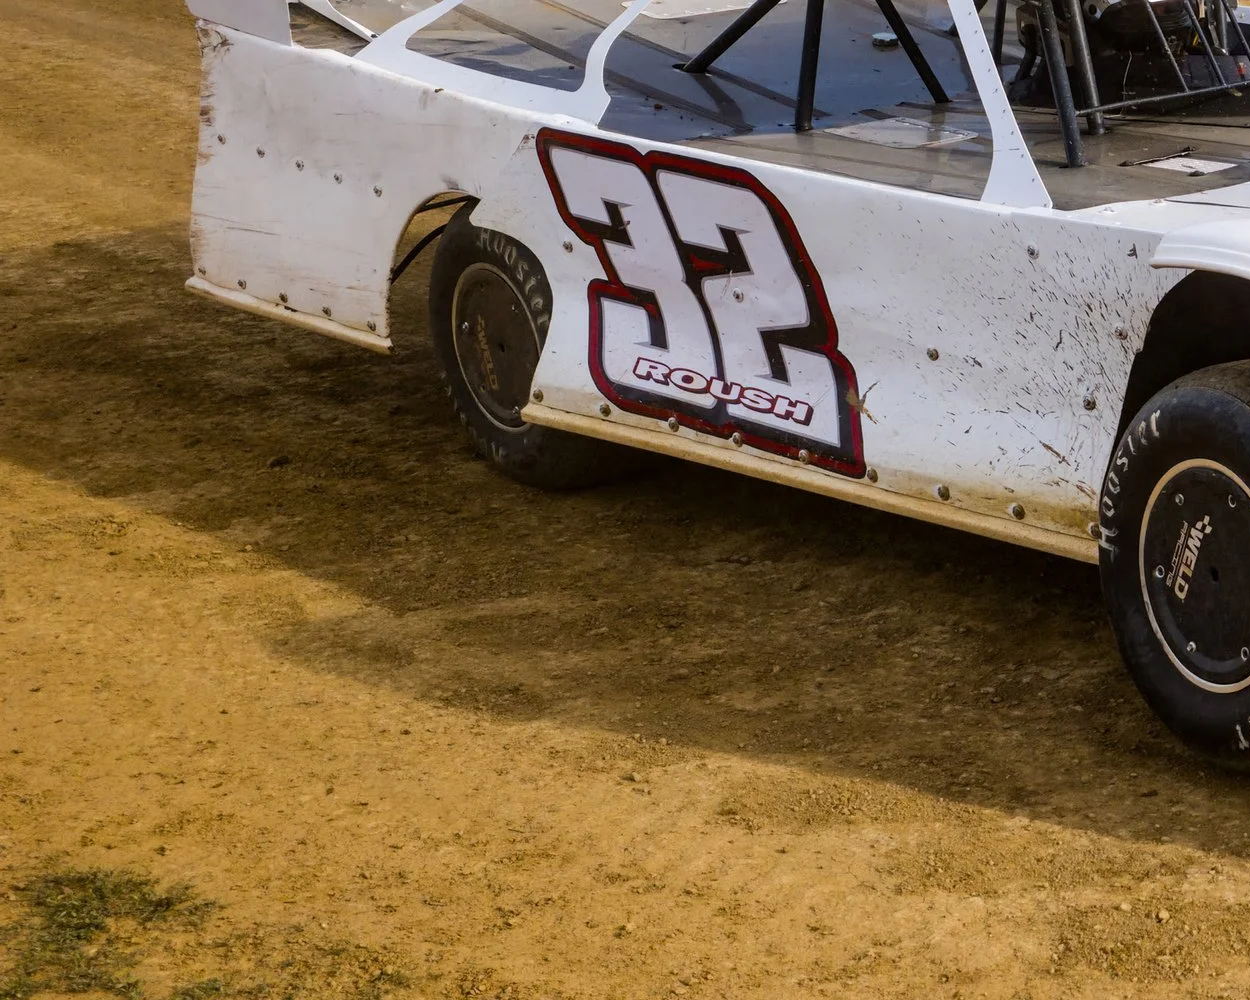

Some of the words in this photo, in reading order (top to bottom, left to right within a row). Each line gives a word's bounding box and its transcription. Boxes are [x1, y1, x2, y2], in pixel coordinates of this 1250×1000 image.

[540, 131, 862, 472] 32
[476, 329, 498, 391] WELD
[633, 357, 813, 426] ROUSH
[1174, 525, 1204, 600] WELD
